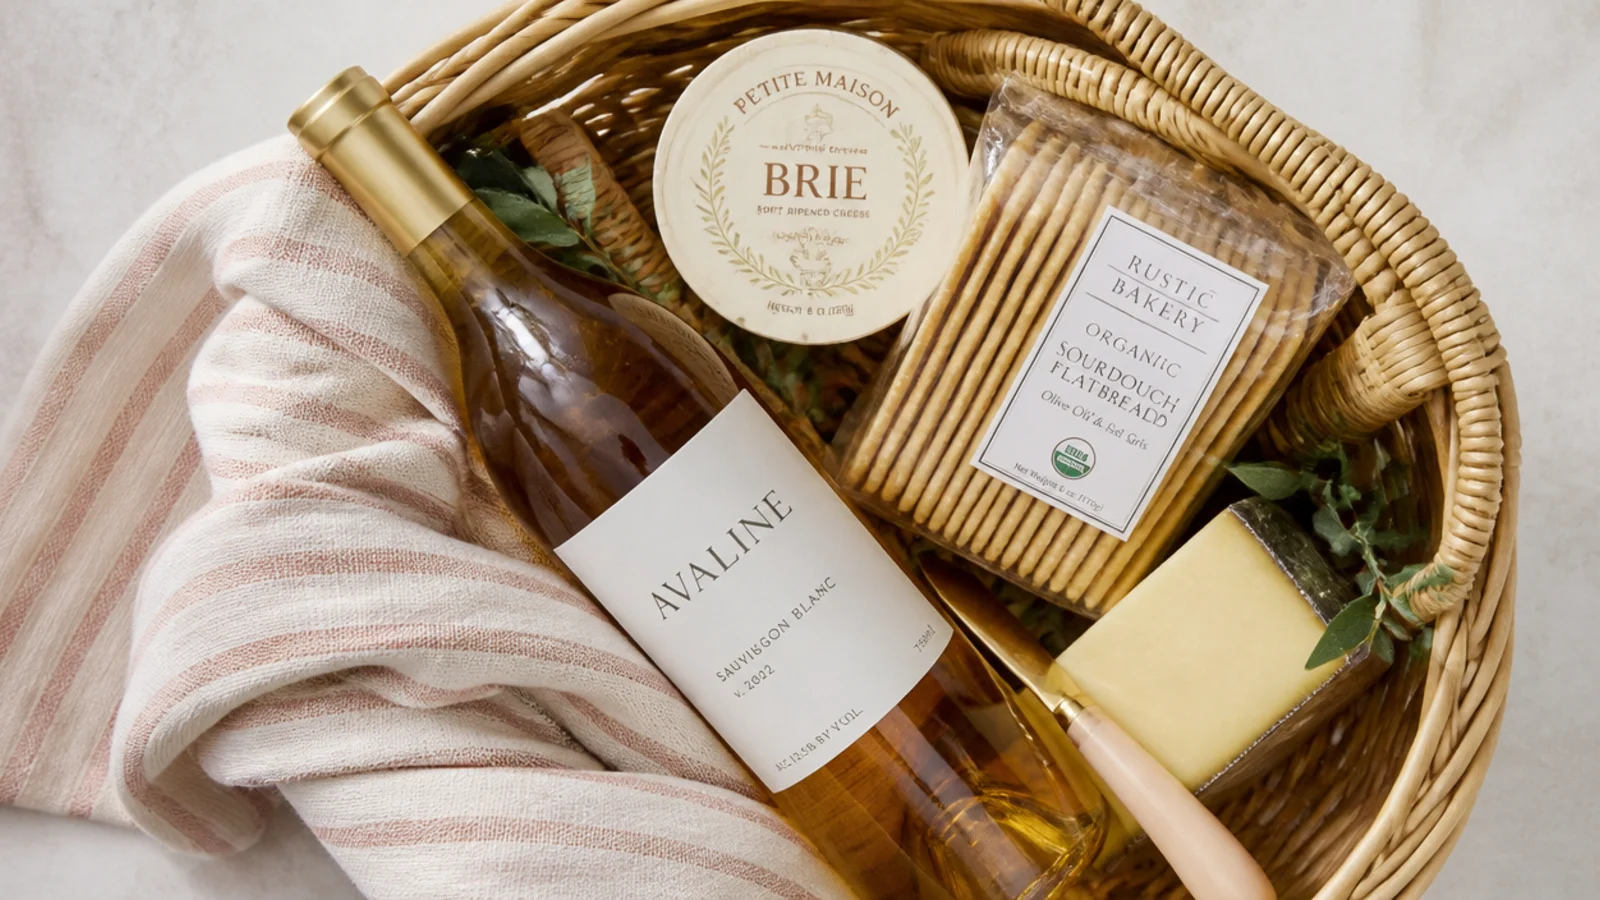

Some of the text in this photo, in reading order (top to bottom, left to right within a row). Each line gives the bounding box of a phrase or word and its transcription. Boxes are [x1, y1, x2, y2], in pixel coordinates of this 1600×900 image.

[733, 71, 900, 119] PETITE MAISON
[763, 162, 868, 200] BRIE
[1111, 277, 1205, 334] BAKERY
[1127, 254, 1215, 309] RUSTIC
[649, 489, 793, 620] AVALINE
